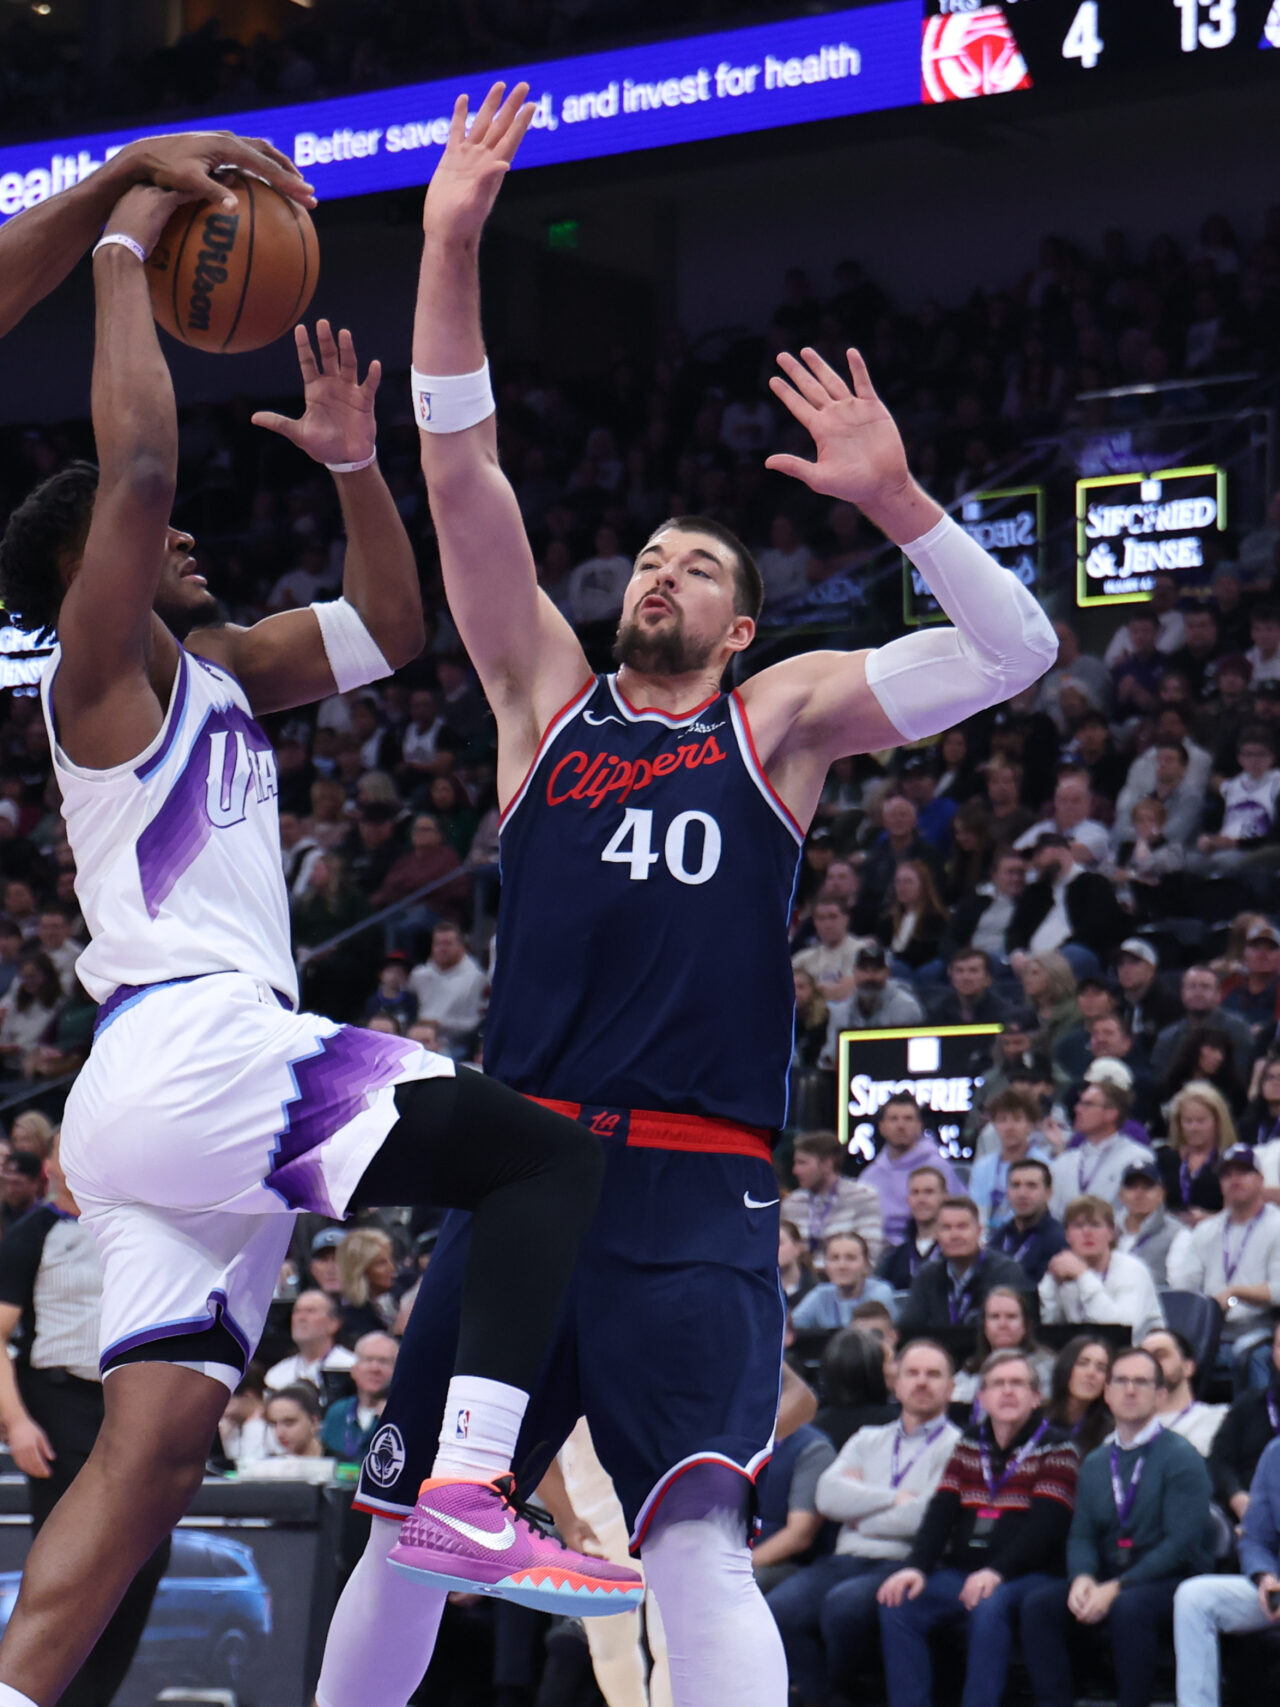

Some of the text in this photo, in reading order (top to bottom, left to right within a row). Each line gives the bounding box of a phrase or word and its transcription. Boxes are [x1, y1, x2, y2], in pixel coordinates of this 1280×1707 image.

[1062, 1, 1103, 68] 4
[1173, 0, 1236, 52] 13
[294, 127, 383, 167] Better
[385, 117, 451, 153] save
[562, 81, 619, 123] and
[622, 67, 710, 113] invest
[715, 61, 761, 98] for
[765, 42, 861, 90] health
[188, 213, 240, 331] Wilson
[546, 735, 727, 808] Clippers
[601, 807, 722, 885] 40
